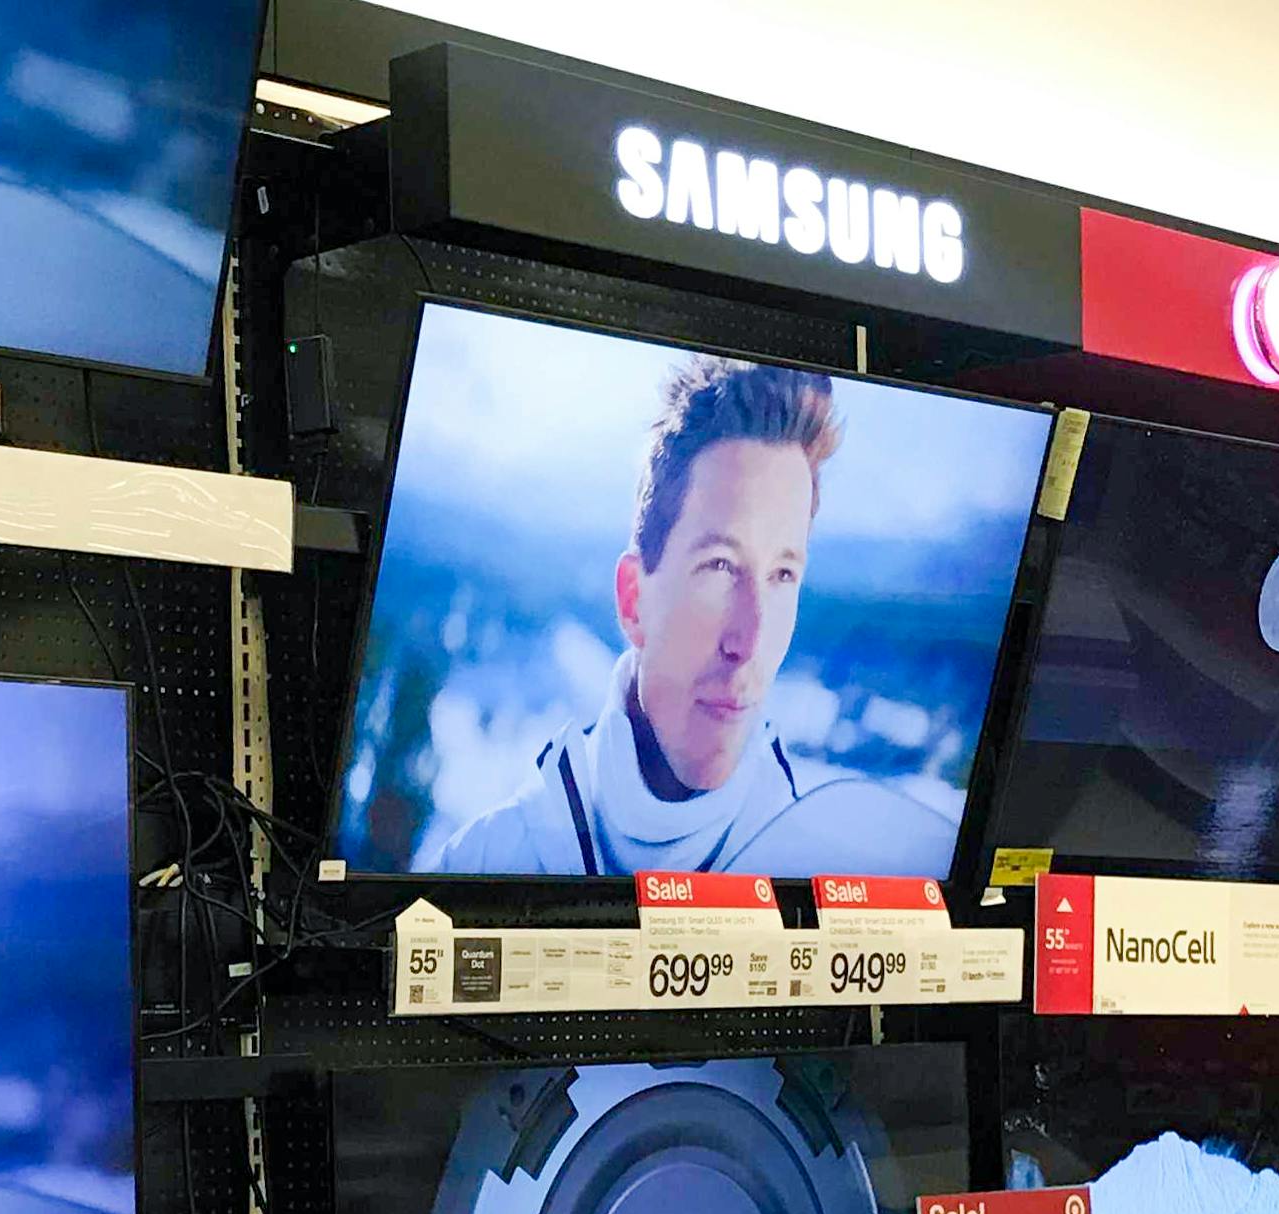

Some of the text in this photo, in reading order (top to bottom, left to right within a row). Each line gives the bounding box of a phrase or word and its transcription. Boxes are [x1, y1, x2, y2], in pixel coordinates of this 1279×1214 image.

[616, 124, 966, 285] SAMSUNG
[646, 876, 693, 900] Sale!
[824, 880, 868, 902] Sale!
[462, 950, 494, 960] Quantum
[1106, 927, 1217, 965] NanoCell
[471, 960, 485, 969] Dot
